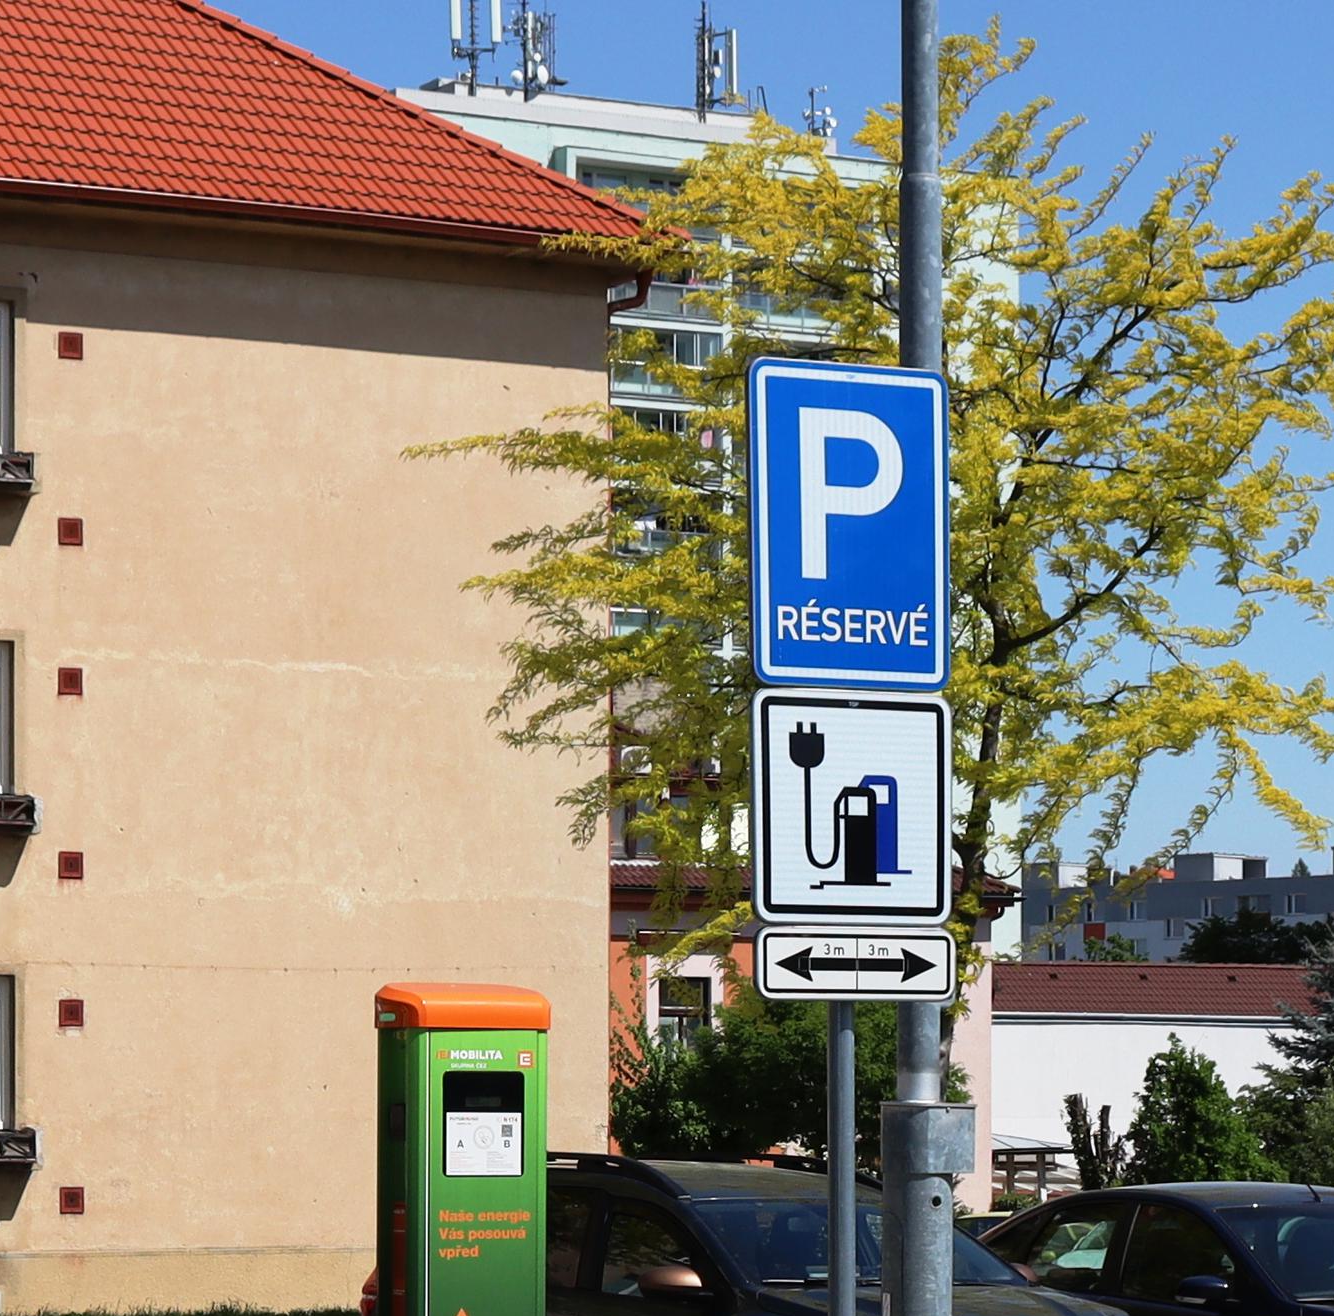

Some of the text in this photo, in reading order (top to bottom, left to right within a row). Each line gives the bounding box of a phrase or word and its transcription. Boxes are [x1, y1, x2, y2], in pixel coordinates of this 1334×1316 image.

[798, 406, 904, 580] P
[777, 599, 929, 647] RÉSERVÉ
[824, 943, 845, 956] 3 m
[868, 944, 889, 956] 3 m
[450, 1050, 503, 1060] MOBILITA
[457, 1139, 465, 1149] A
[503, 1139, 511, 1149] B
[478, 1208, 532, 1224] energie
[439, 1225, 527, 1243] Vás posouvá
[438, 1244, 480, 1261] vpřed
